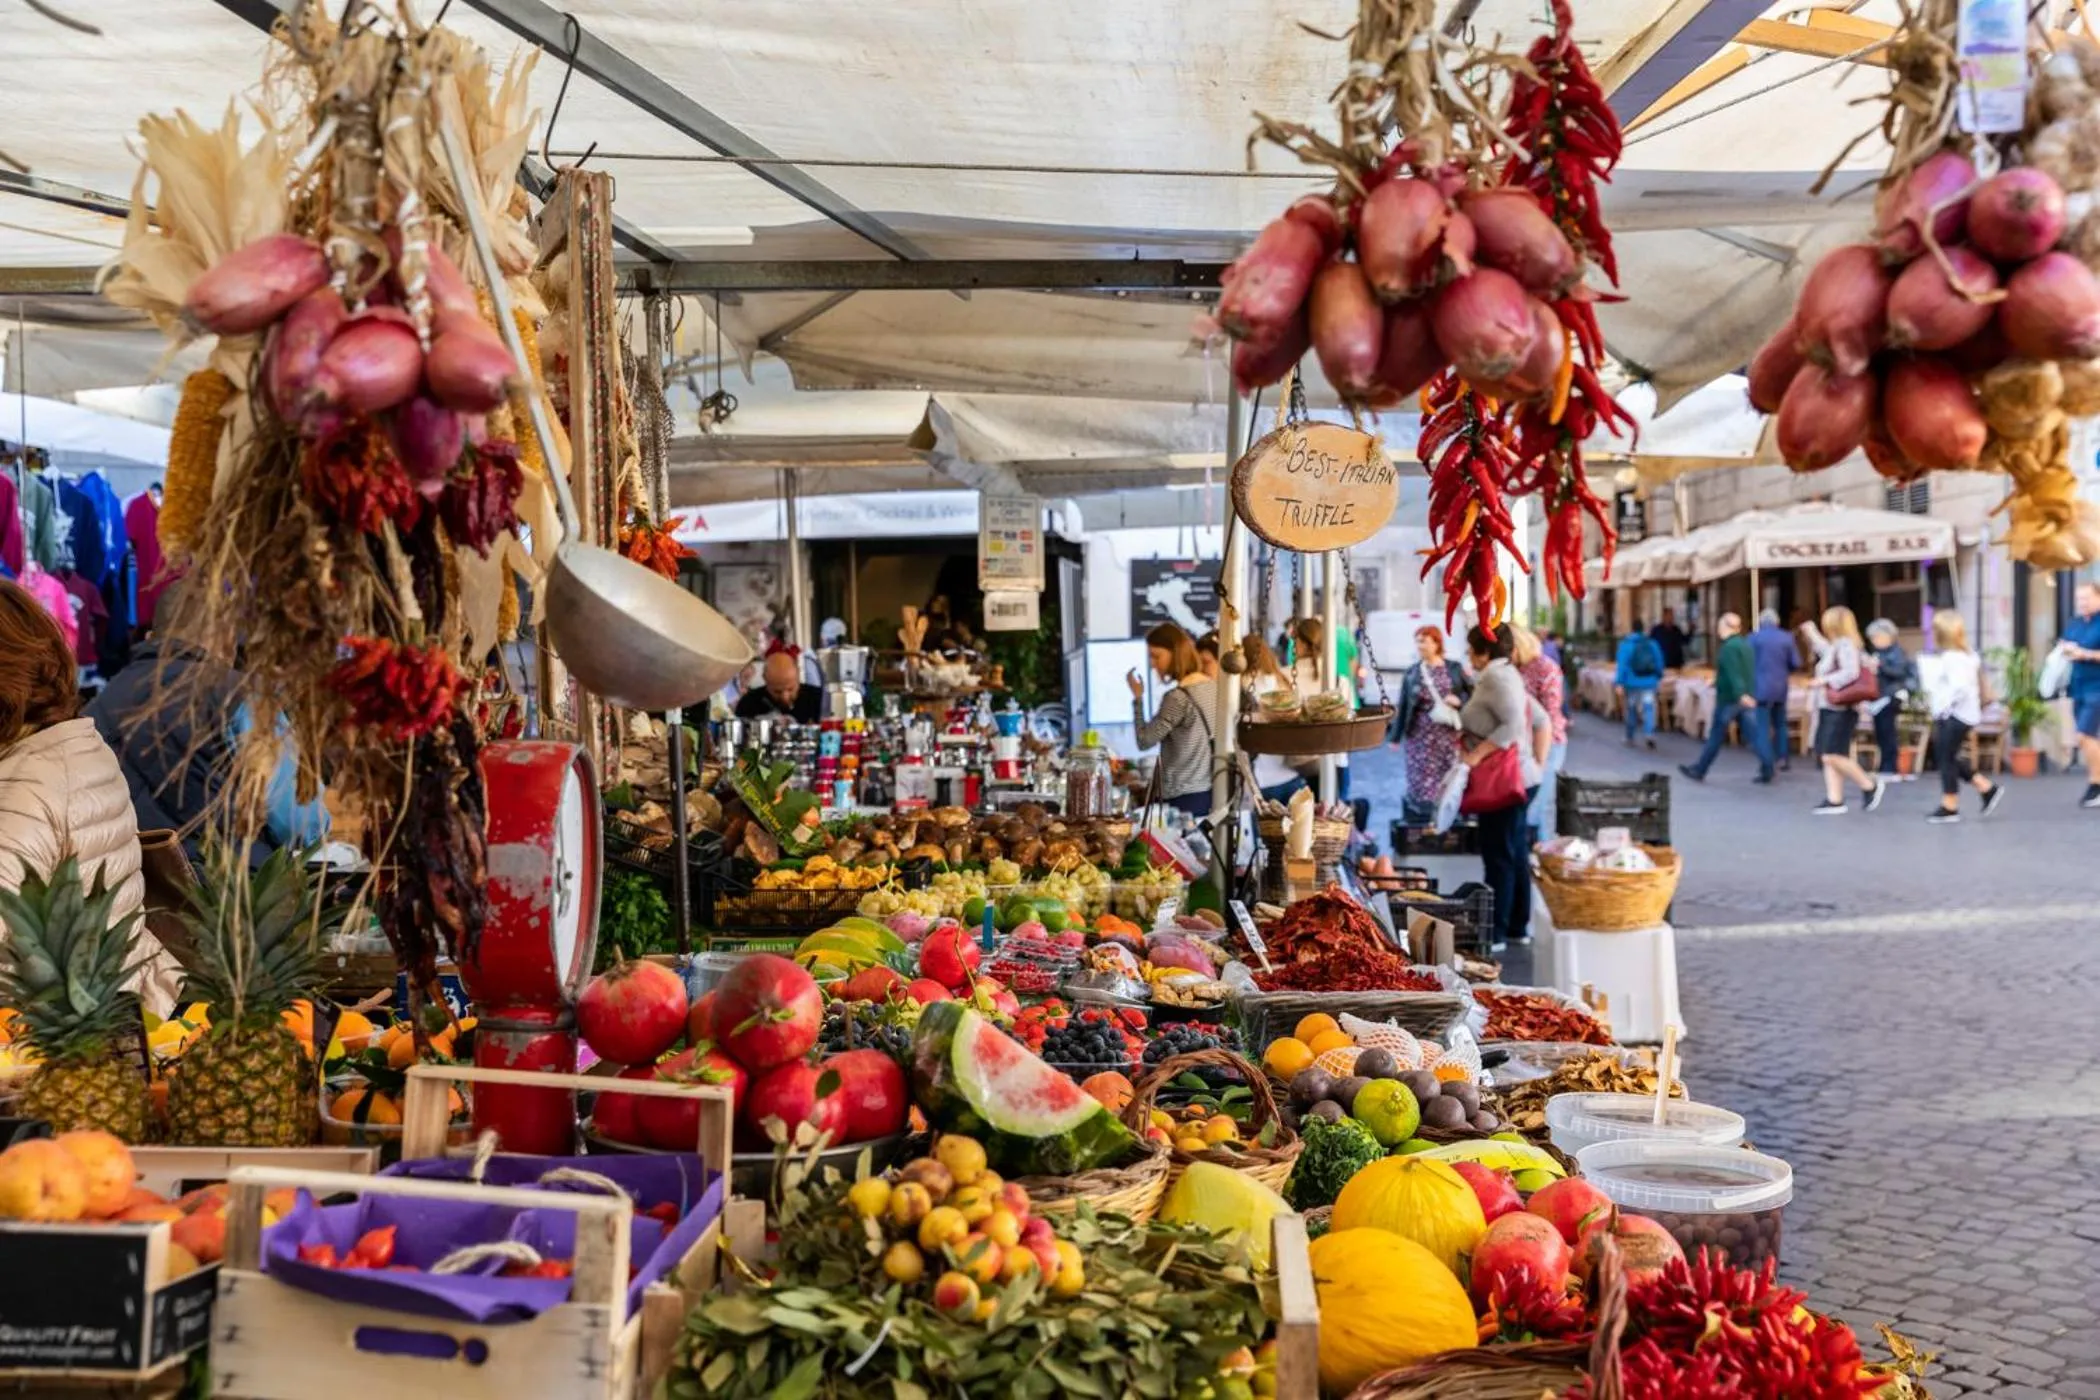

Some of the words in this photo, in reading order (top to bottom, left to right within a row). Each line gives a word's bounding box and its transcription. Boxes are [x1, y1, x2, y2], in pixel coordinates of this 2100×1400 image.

[1275, 497, 1355, 528] TRUFFLE
[1768, 539, 1868, 558] COCKTAIL
[1888, 536, 1930, 551] BAR
